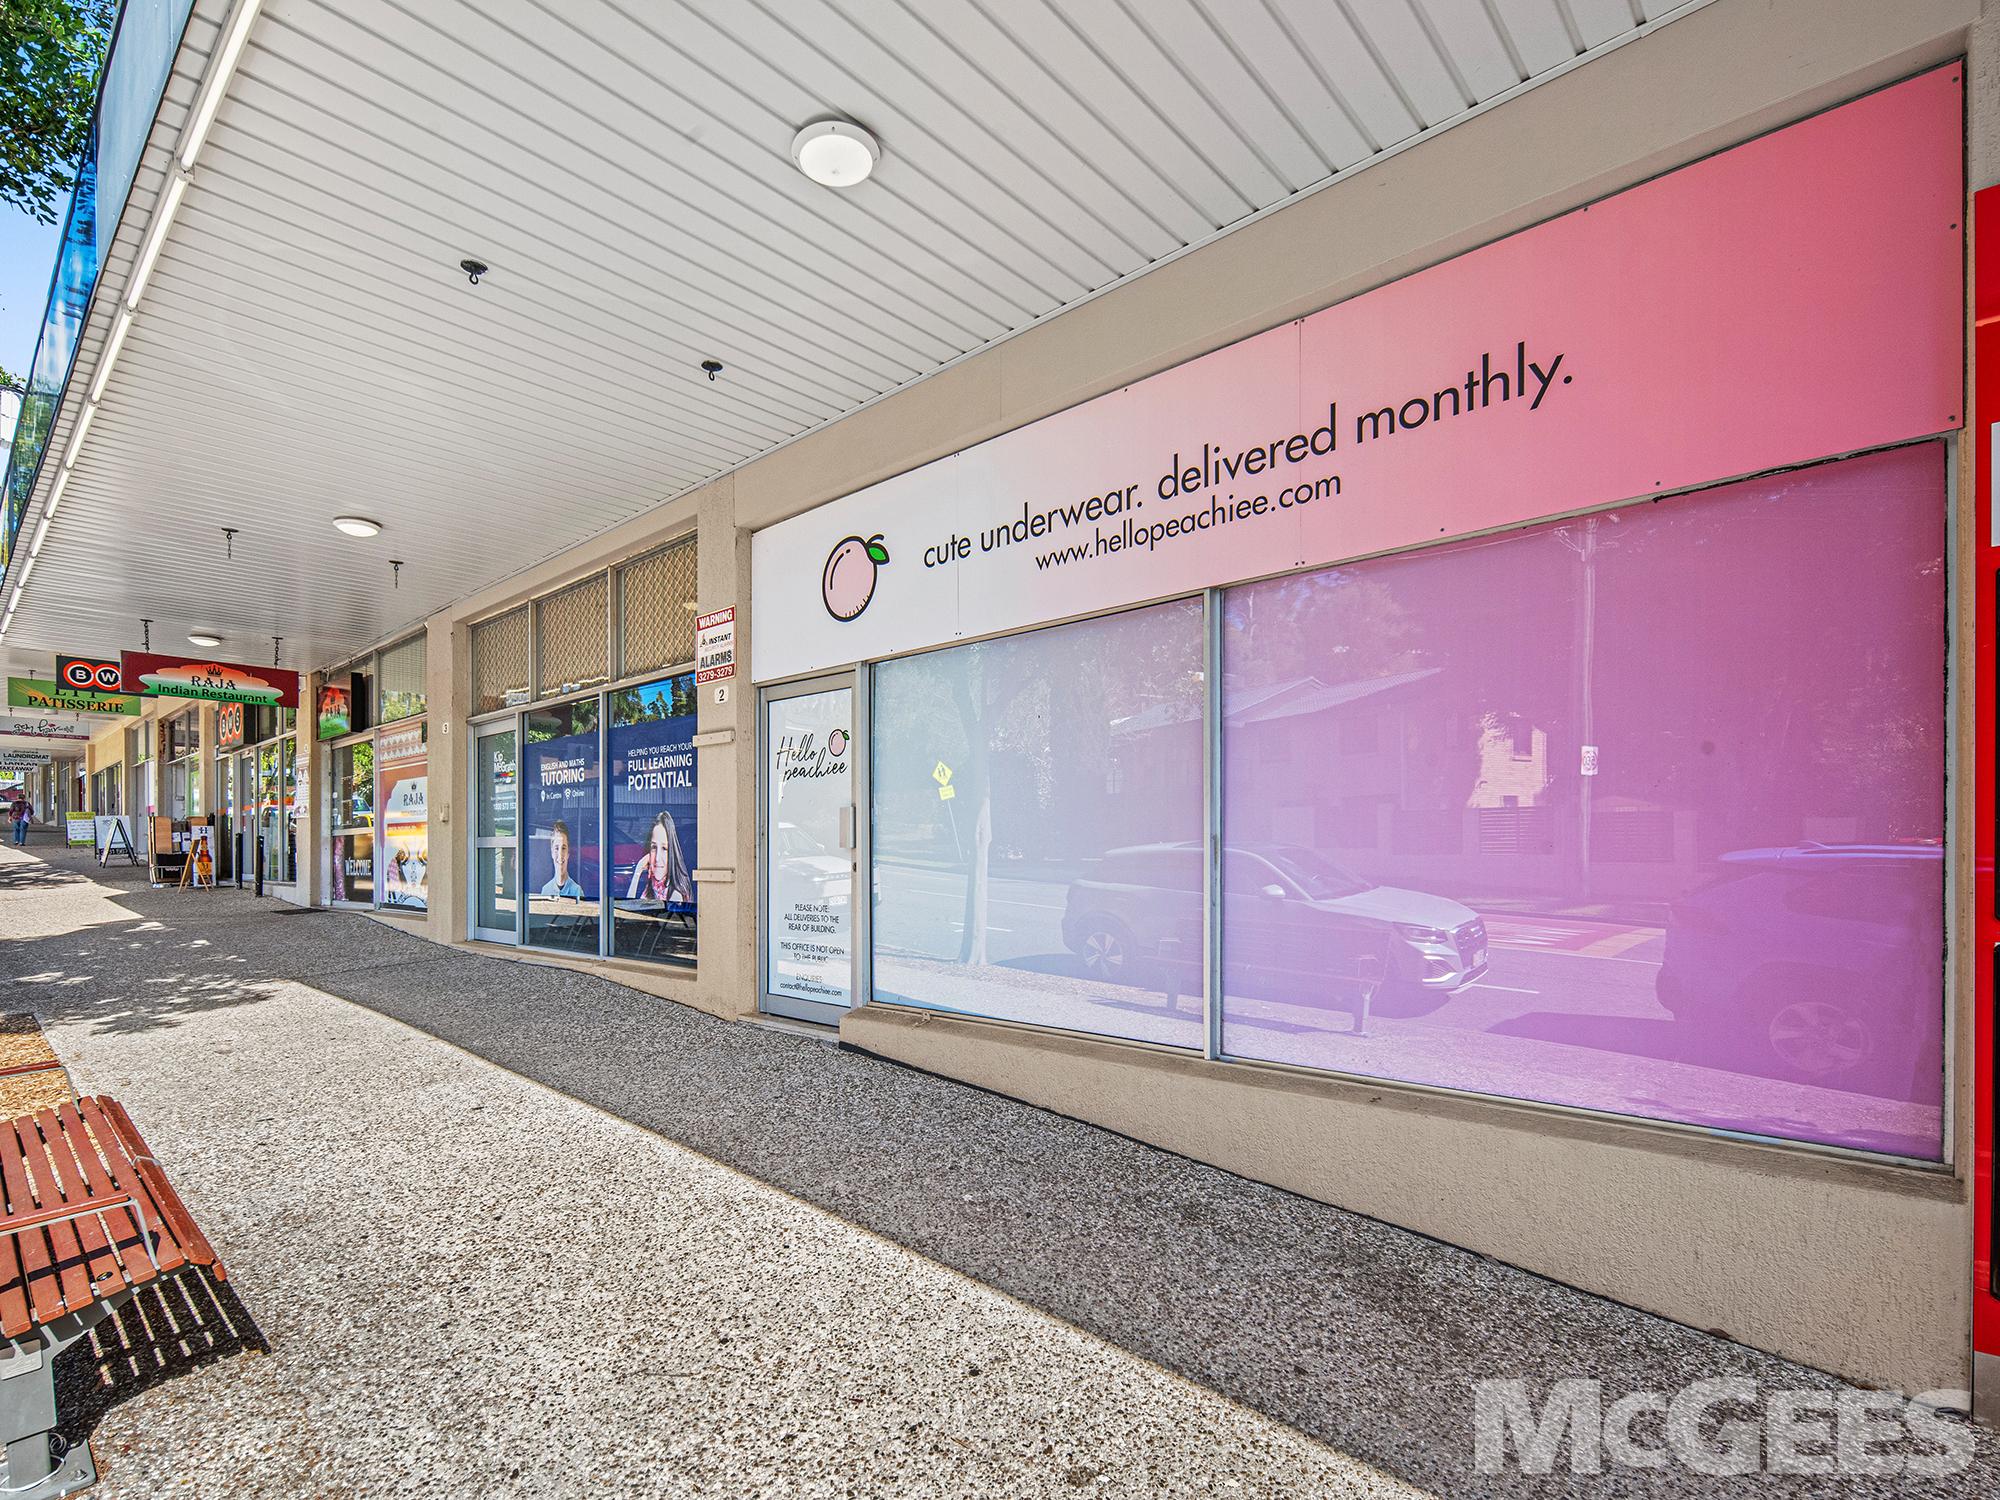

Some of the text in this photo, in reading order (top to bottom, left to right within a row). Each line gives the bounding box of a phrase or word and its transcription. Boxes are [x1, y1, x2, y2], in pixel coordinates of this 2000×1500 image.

[923, 340, 1573, 568] cute underwear. delivered monthly.
[1035, 474, 1341, 571] www.hellopeachiee.com
[698, 608, 733, 629] WARNING
[708, 632, 732, 645] INSTANT
[700, 649, 732, 669] ALARMS
[698, 665, 733, 682] 3279-3279
[190, 675, 238, 691] RAJA
[158, 683, 268, 704] Indian Restaurant
[718, 688, 725, 702] 2
[27, 695, 125, 713] PATISSERIE
[627, 741, 693, 757] HELPING YOU REACH YOUR
[776, 732, 818, 770] Hello
[540, 758, 585, 771] ENGLISH AND MATHS
[627, 753, 693, 772] FULL LEARNING
[782, 746, 848, 783] peachiee
[540, 767, 585, 786] TUTORING
[627, 769, 693, 792] POTENTIAL
[403, 792, 424, 807] RAJA
[344, 857, 372, 877] WELCOME
[794, 903, 813, 912] PLEASE
[783, 913, 839, 924] ALL DELIVERIES TO THE
[788, 923, 801, 931] REAR
[801, 923, 810, 932] OF
[780, 941, 791, 950] THIS
[791, 942, 810, 952] OFFICE
[816, 945, 828, 954] NOT
[828, 946, 845, 955] OPEN
[793, 953, 802, 961] TO
